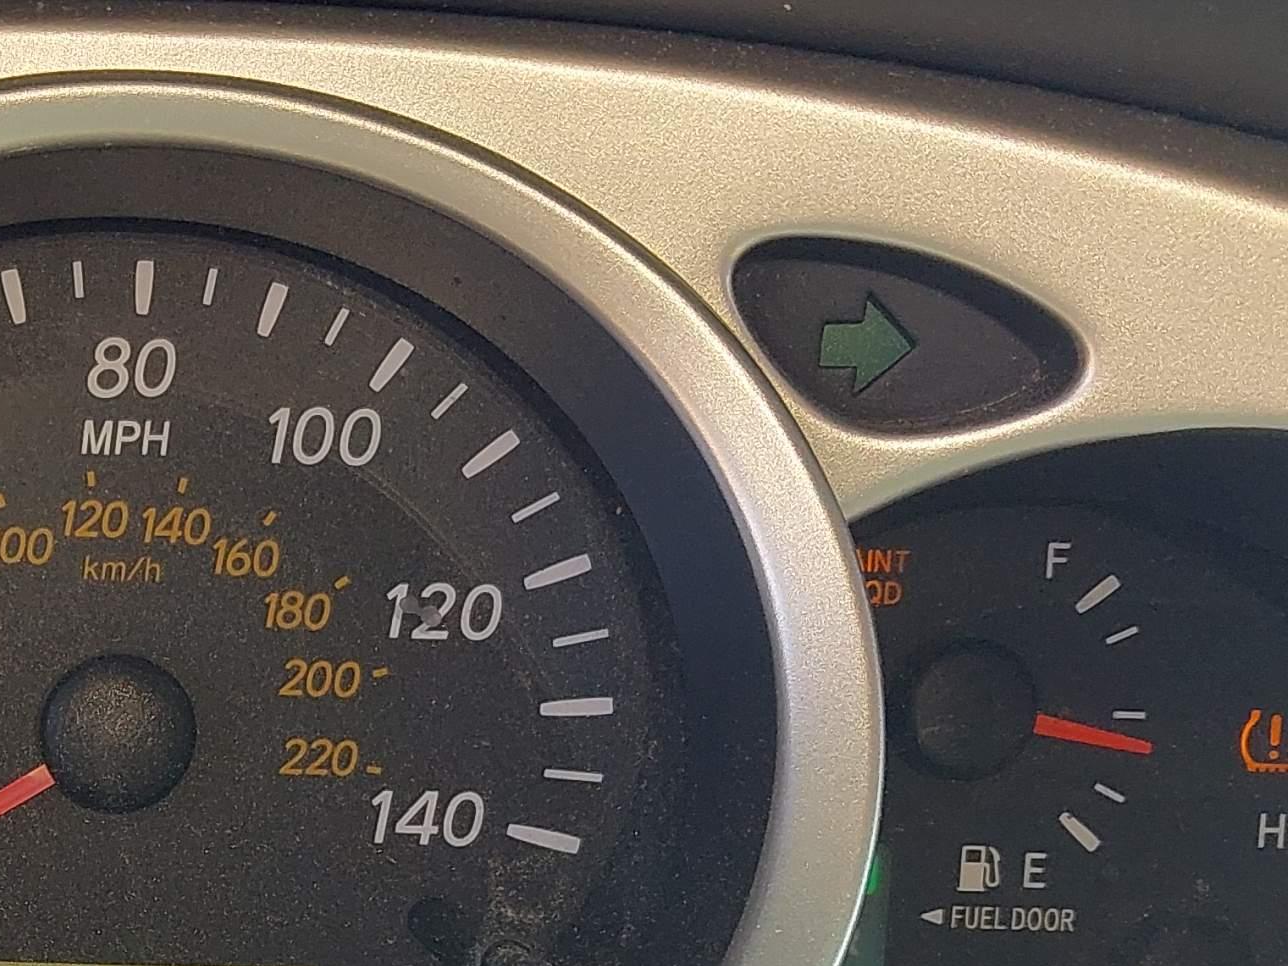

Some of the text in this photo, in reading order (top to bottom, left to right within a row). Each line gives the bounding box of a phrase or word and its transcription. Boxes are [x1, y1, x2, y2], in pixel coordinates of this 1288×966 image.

[87, 336, 177, 399] 80
[81, 419, 171, 457] MPH
[268, 406, 382, 467] 100
[62, 498, 130, 540] 120
[142, 505, 212, 546] 140
[80, 554, 164, 583] km/h
[214, 537, 281, 578] 160
[1046, 542, 1072, 579] F
[265, 588, 332, 632] 180
[386, 582, 503, 641] 120
[279, 656, 362, 700] 200
[279, 736, 360, 778] 220
[371, 790, 485, 847] 140
[1257, 812, 1287, 849] H
[1023, 852, 1048, 889] E
[950, 905, 1075, 932] FUEL DOOR
